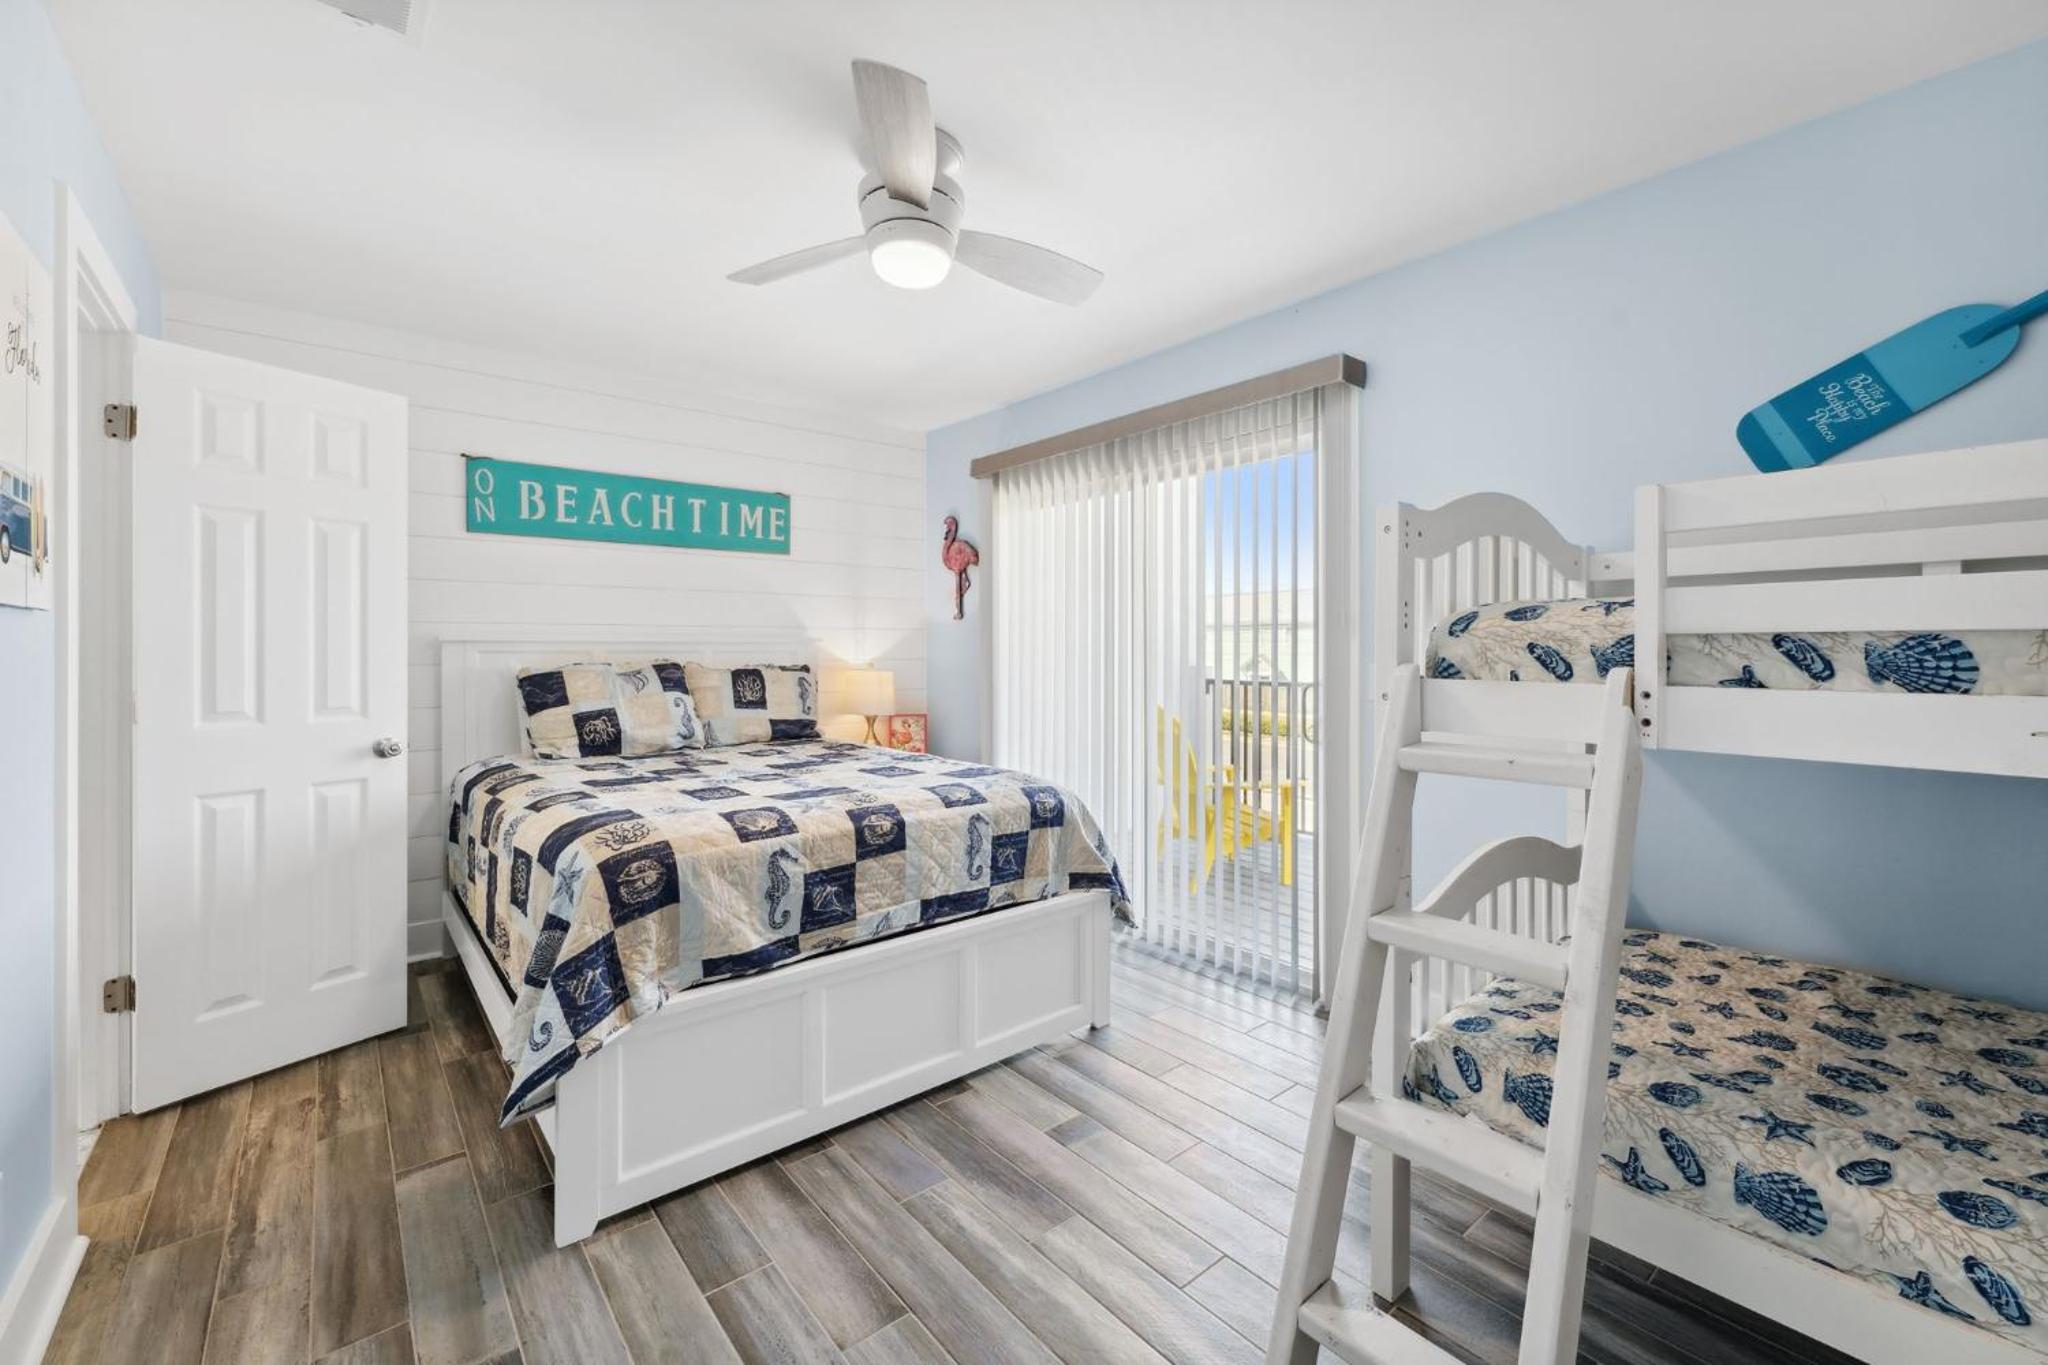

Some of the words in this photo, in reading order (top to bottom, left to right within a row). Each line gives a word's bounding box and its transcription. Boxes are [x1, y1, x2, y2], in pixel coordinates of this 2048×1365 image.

[1818, 383, 1853, 423] Happy
[1845, 373, 1891, 416] Beach
[1806, 408, 1837, 443] Place
[474, 468, 496, 523] ON
